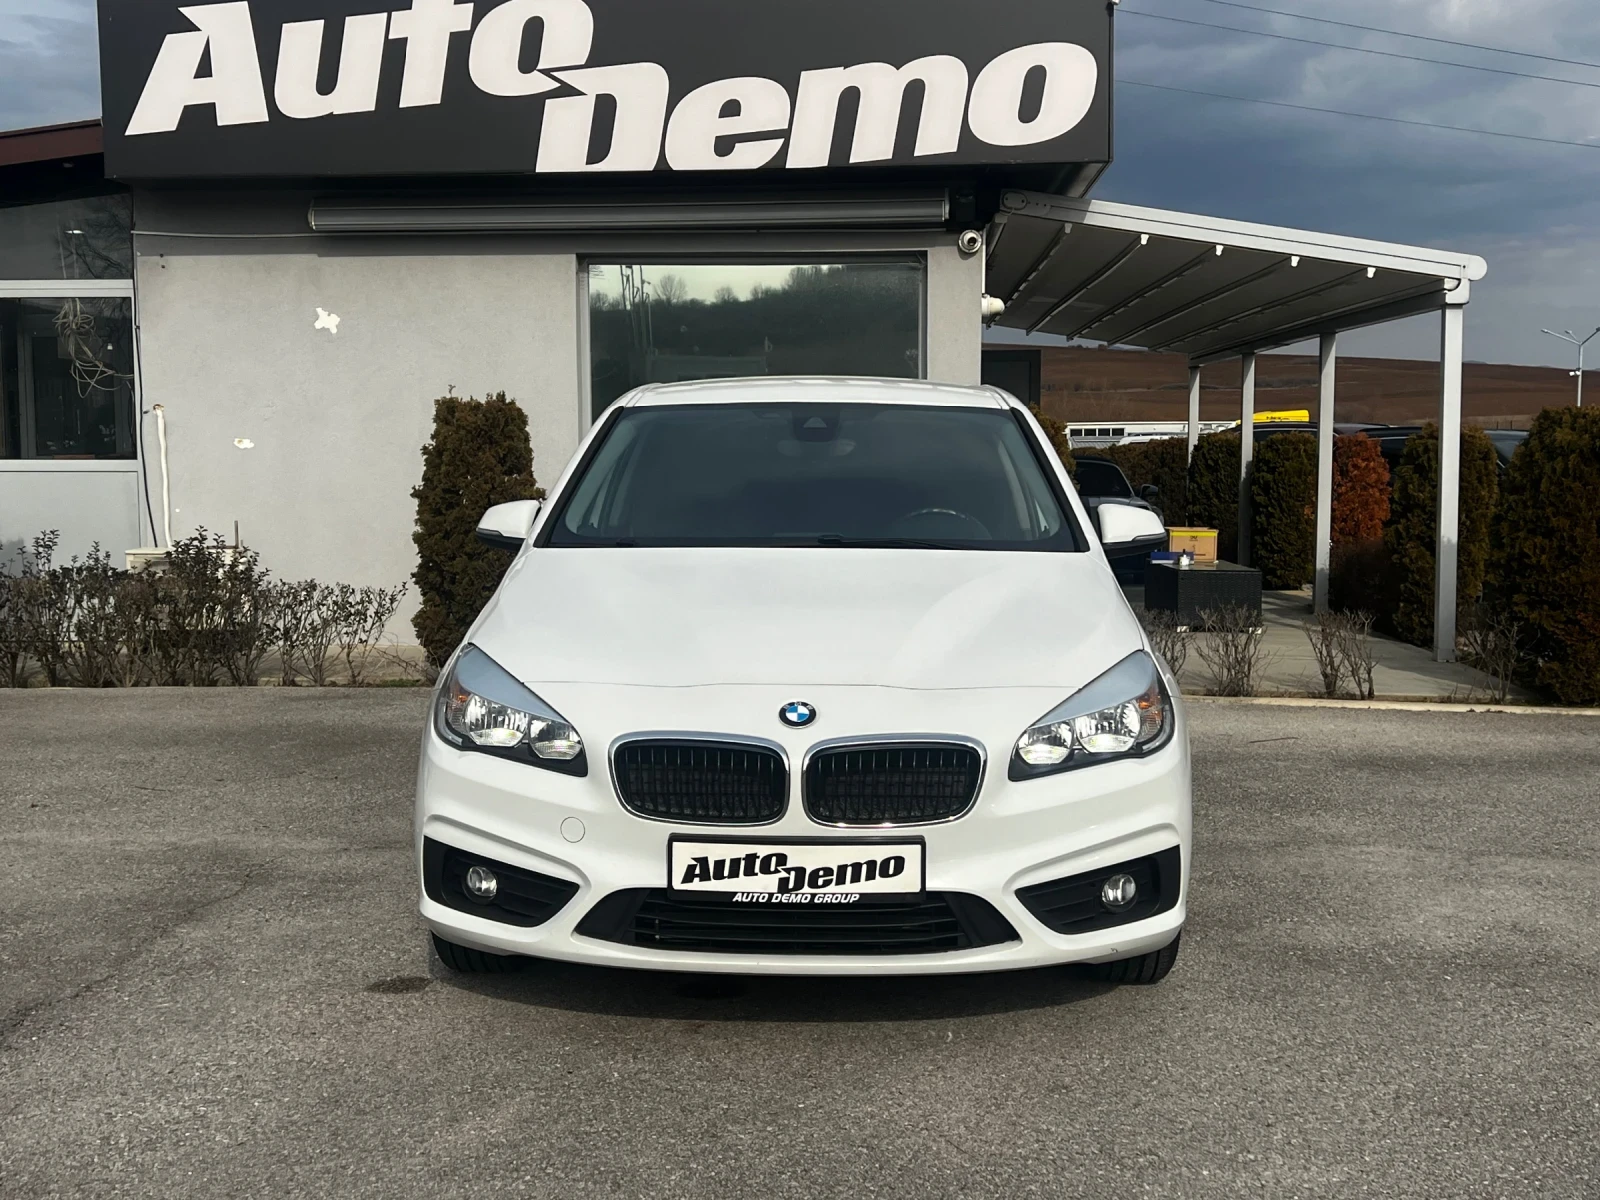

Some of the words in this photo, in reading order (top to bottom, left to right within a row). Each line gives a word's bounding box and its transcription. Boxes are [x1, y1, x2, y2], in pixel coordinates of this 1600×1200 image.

[125, 0, 594, 135] Auto
[536, 42, 1098, 172] Demo
[681, 852, 787, 884] Auto
[777, 855, 906, 893] Demo
[732, 892, 769, 903] AUTO
[771, 893, 811, 903] DEMO
[813, 893, 860, 904] GROUP
